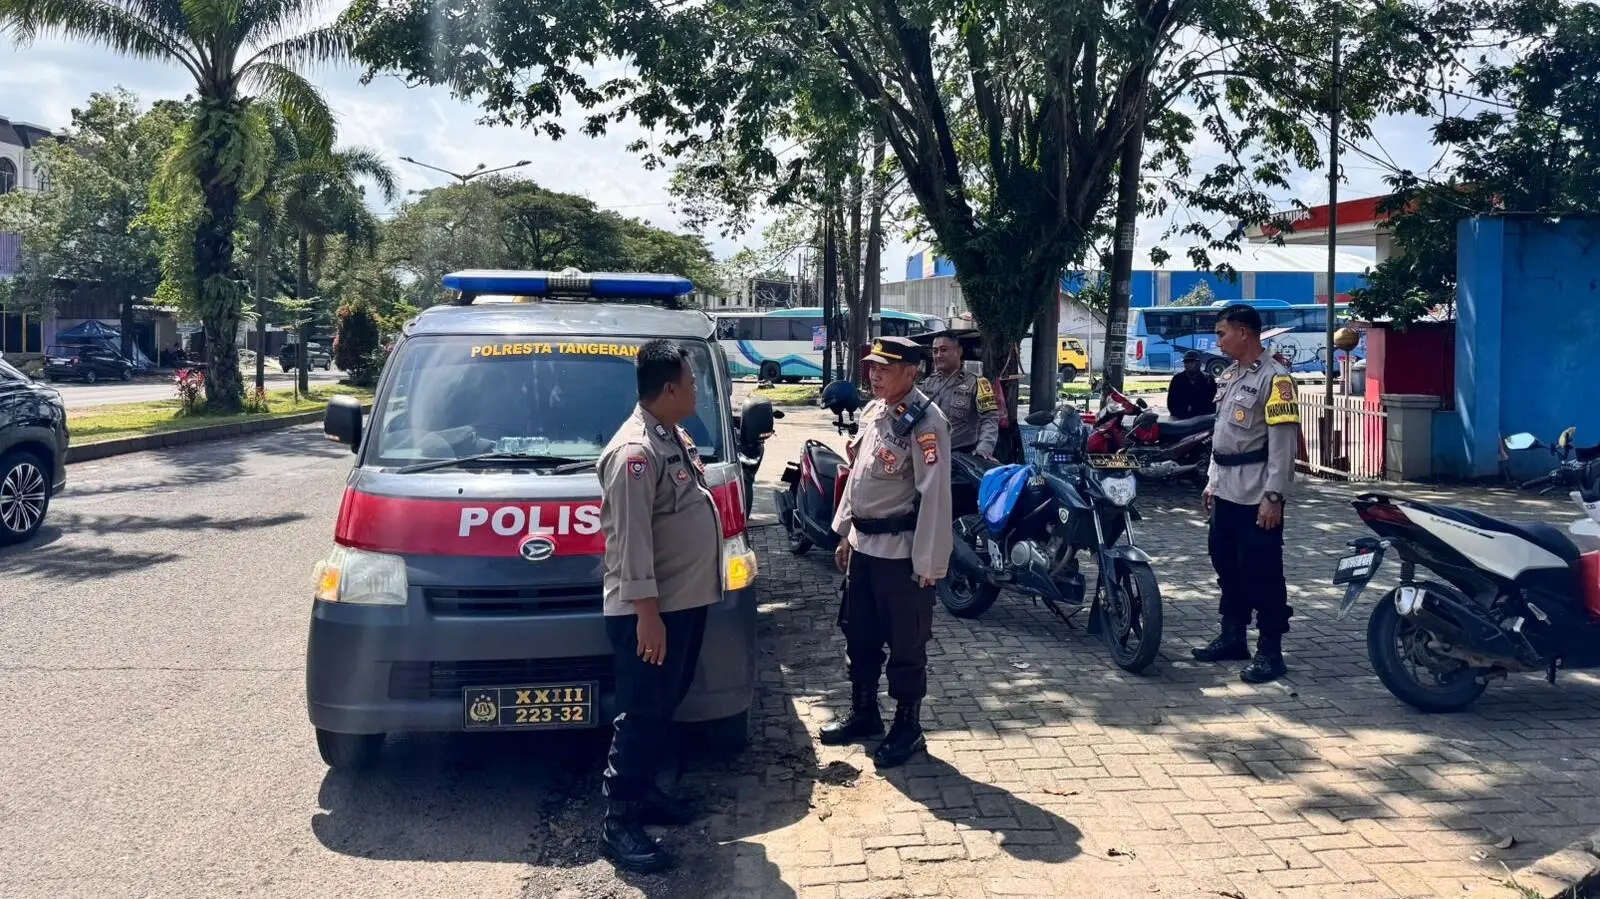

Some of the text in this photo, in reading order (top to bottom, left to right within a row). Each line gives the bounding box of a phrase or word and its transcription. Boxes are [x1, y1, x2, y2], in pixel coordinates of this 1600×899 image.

[471, 342, 640, 357] POLRESTA TANGERAN
[458, 505, 602, 537] POLIS
[515, 688, 583, 704] XXIII
[516, 706, 583, 723] 223-32
